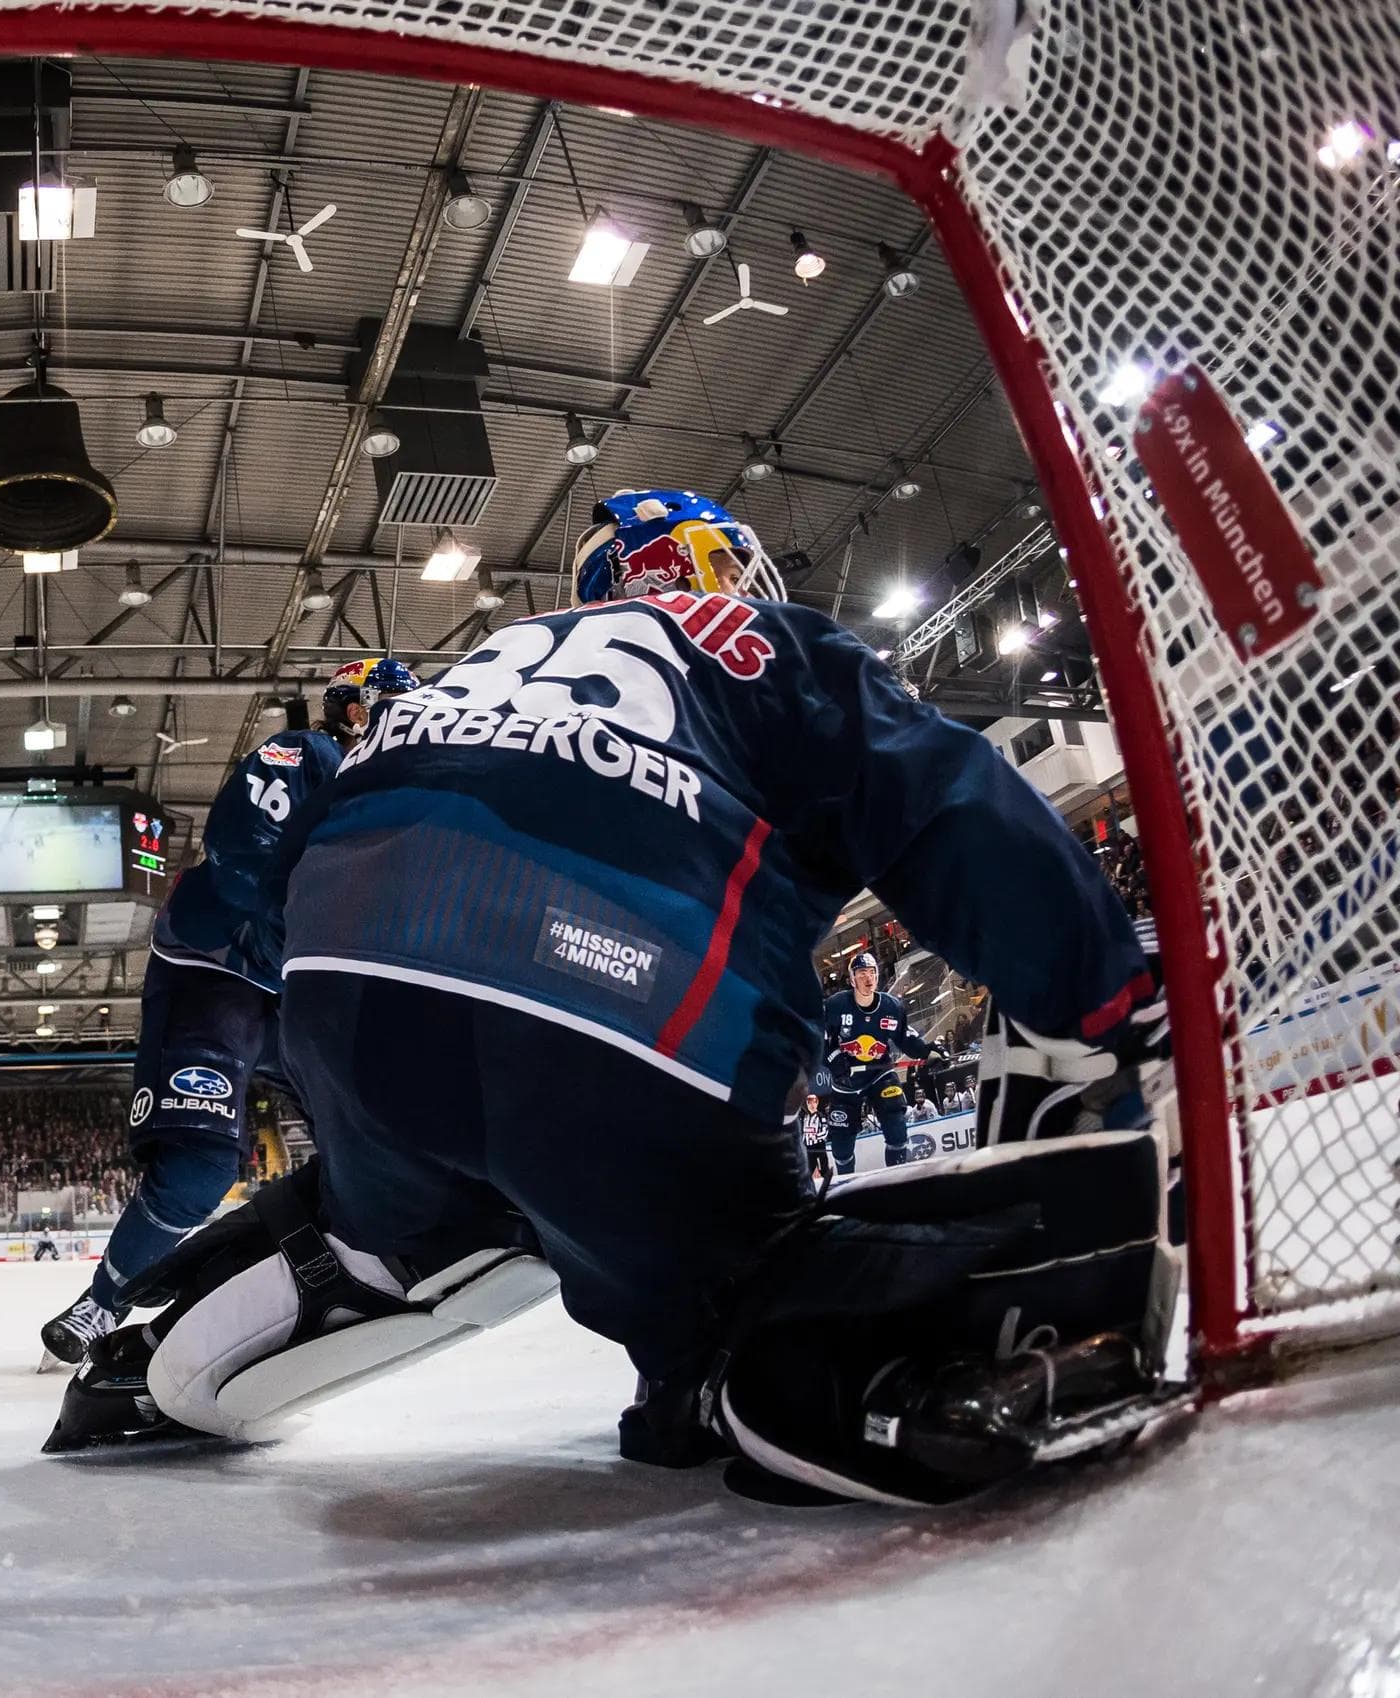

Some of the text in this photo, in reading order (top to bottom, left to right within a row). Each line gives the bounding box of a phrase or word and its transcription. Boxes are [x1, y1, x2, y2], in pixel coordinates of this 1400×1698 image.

[1187, 446, 1211, 483] in
[1203, 479, 1285, 623] München
[550, 921, 652, 971] #MISSION
[554, 942, 638, 986] 4MINGA
[841, 1014, 853, 1026] 18
[160, 1098, 236, 1119] SUBARU
